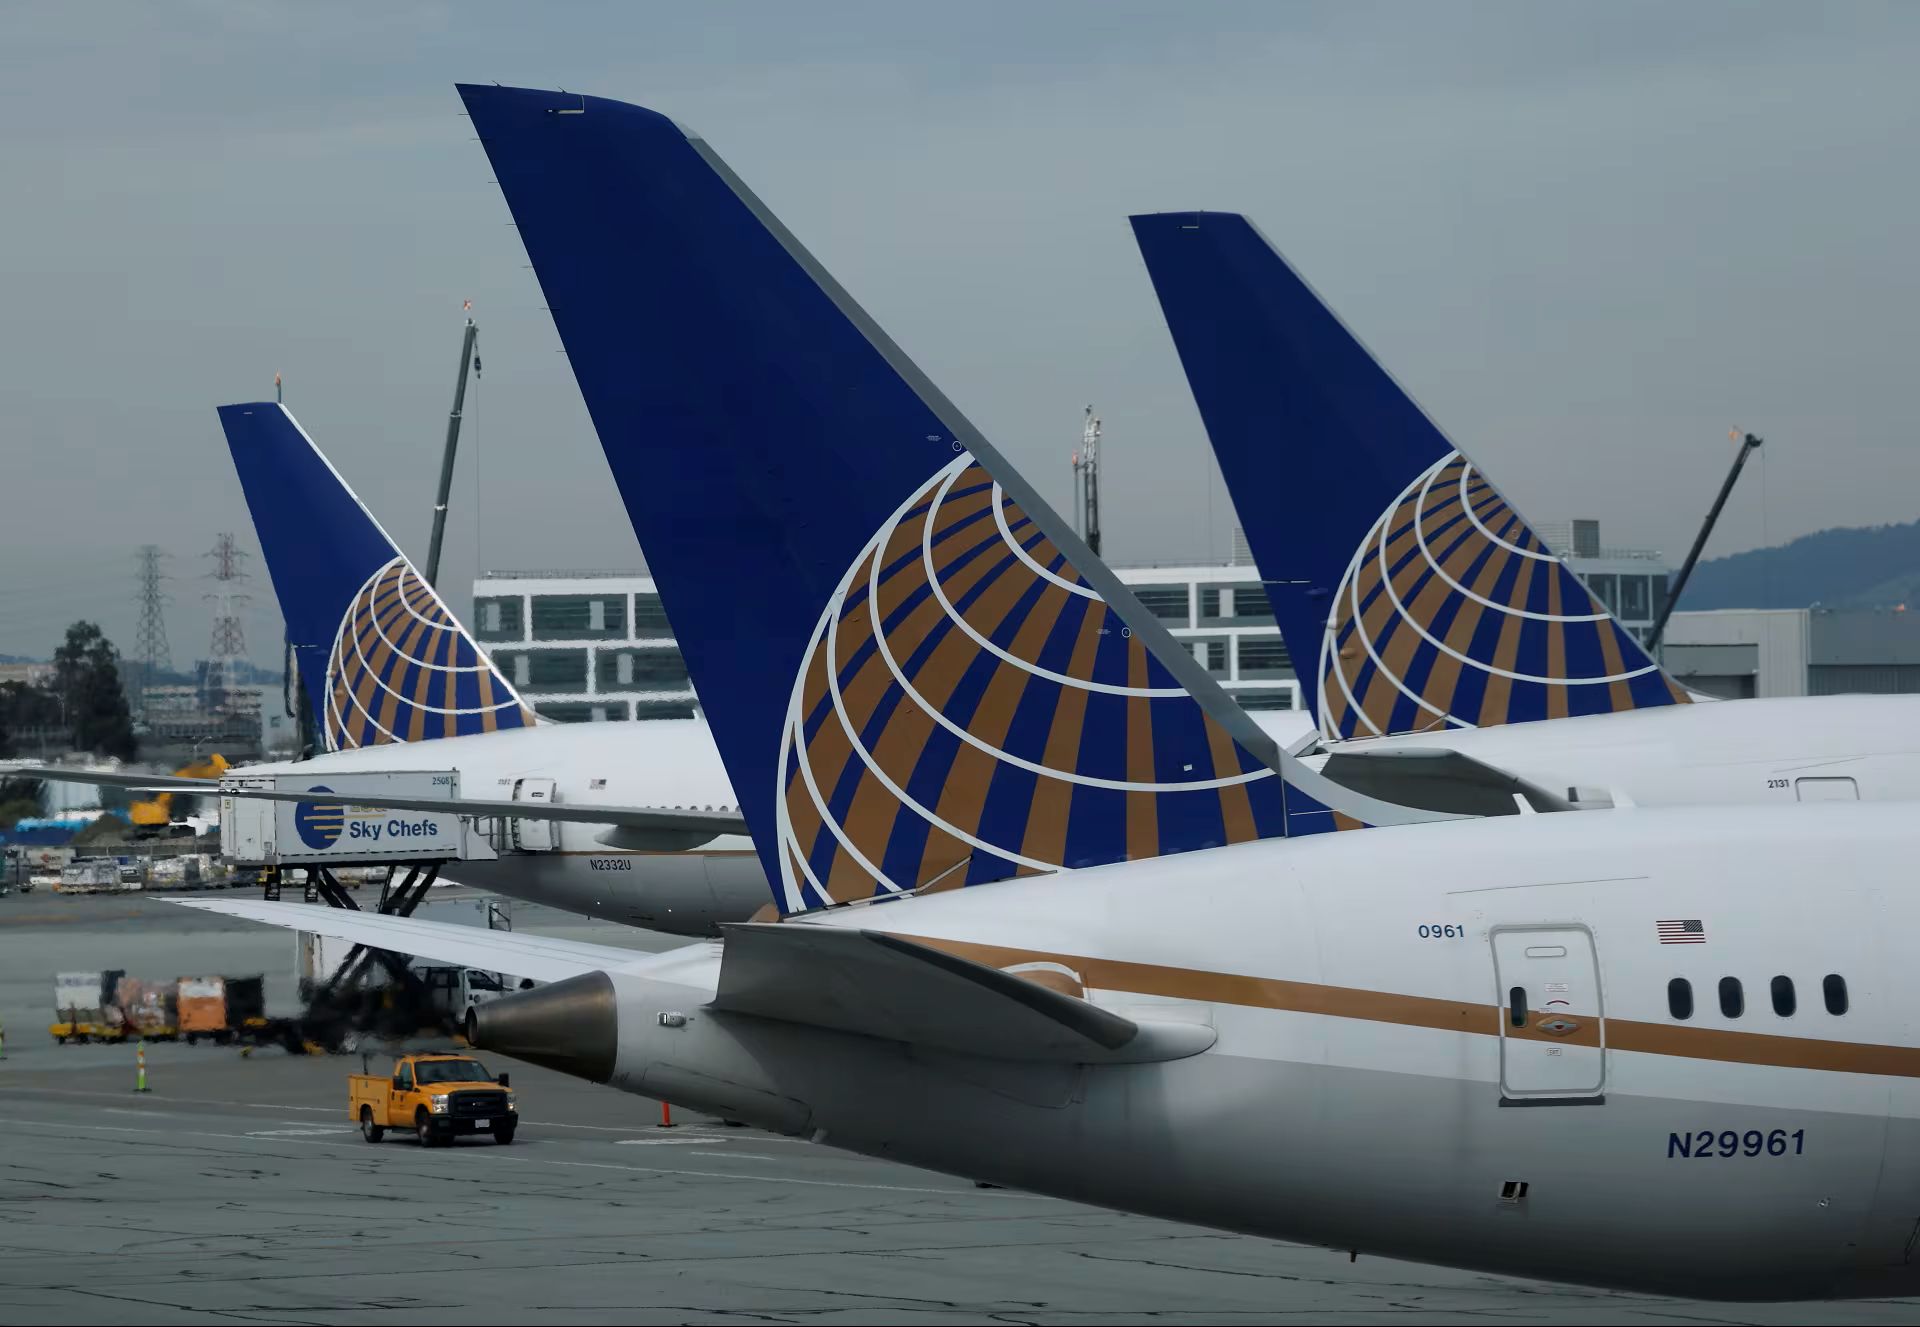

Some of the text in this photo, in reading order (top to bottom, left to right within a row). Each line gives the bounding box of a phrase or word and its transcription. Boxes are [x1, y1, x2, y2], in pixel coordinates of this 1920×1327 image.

[1768, 779, 1789, 788] 2131
[350, 819, 437, 840] Sky Chefs
[590, 859, 631, 870] N2332U
[1418, 924, 1465, 938] 0961
[1667, 1129, 1805, 1158] N29961
